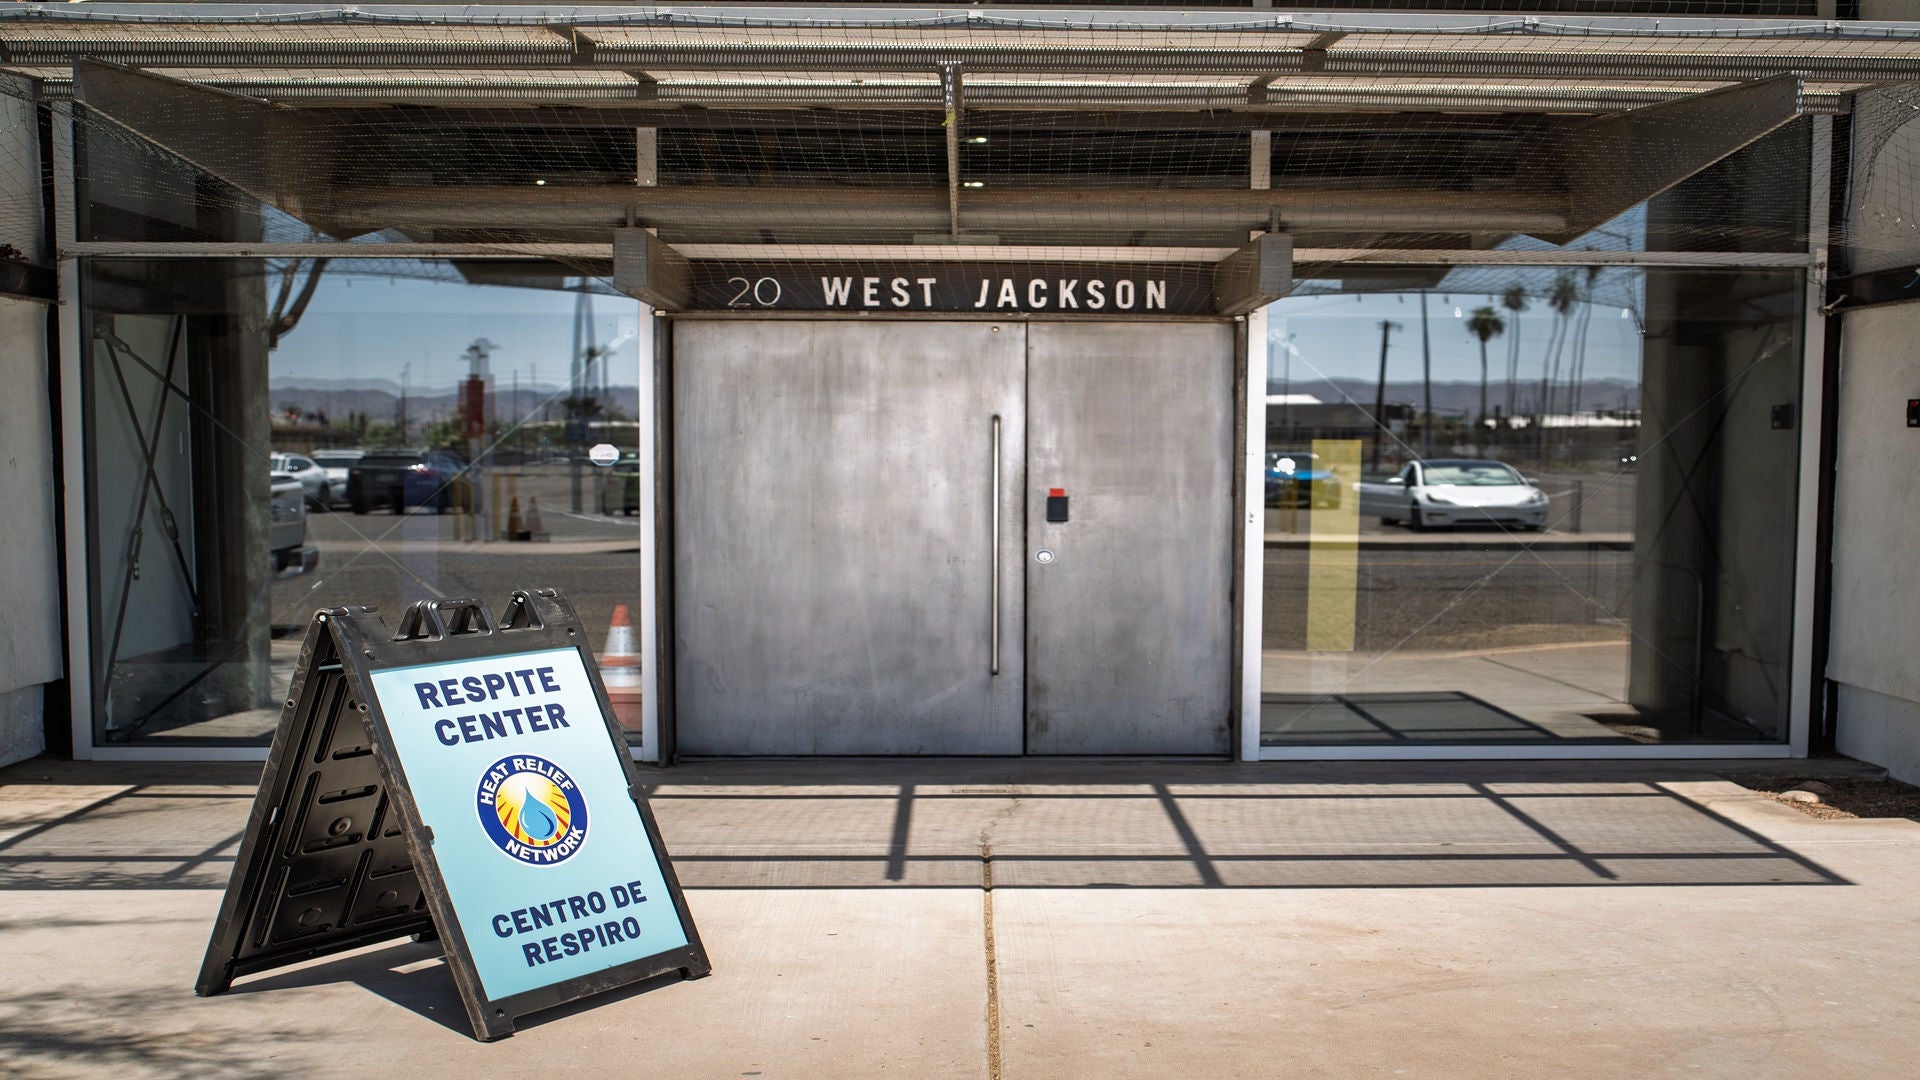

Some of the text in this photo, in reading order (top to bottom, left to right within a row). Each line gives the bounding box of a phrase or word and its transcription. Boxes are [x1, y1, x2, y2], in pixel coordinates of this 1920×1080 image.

[727, 276, 1168, 309] 20 WEST JACKSON
[414, 666, 562, 710] RESPITE
[434, 703, 571, 746] CENTER
[480, 758, 574, 805] HEAT RELIEF
[505, 824, 584, 862] NETWORK
[491, 880, 648, 938] CENTRO DE
[522, 916, 641, 968] RESPIRO
